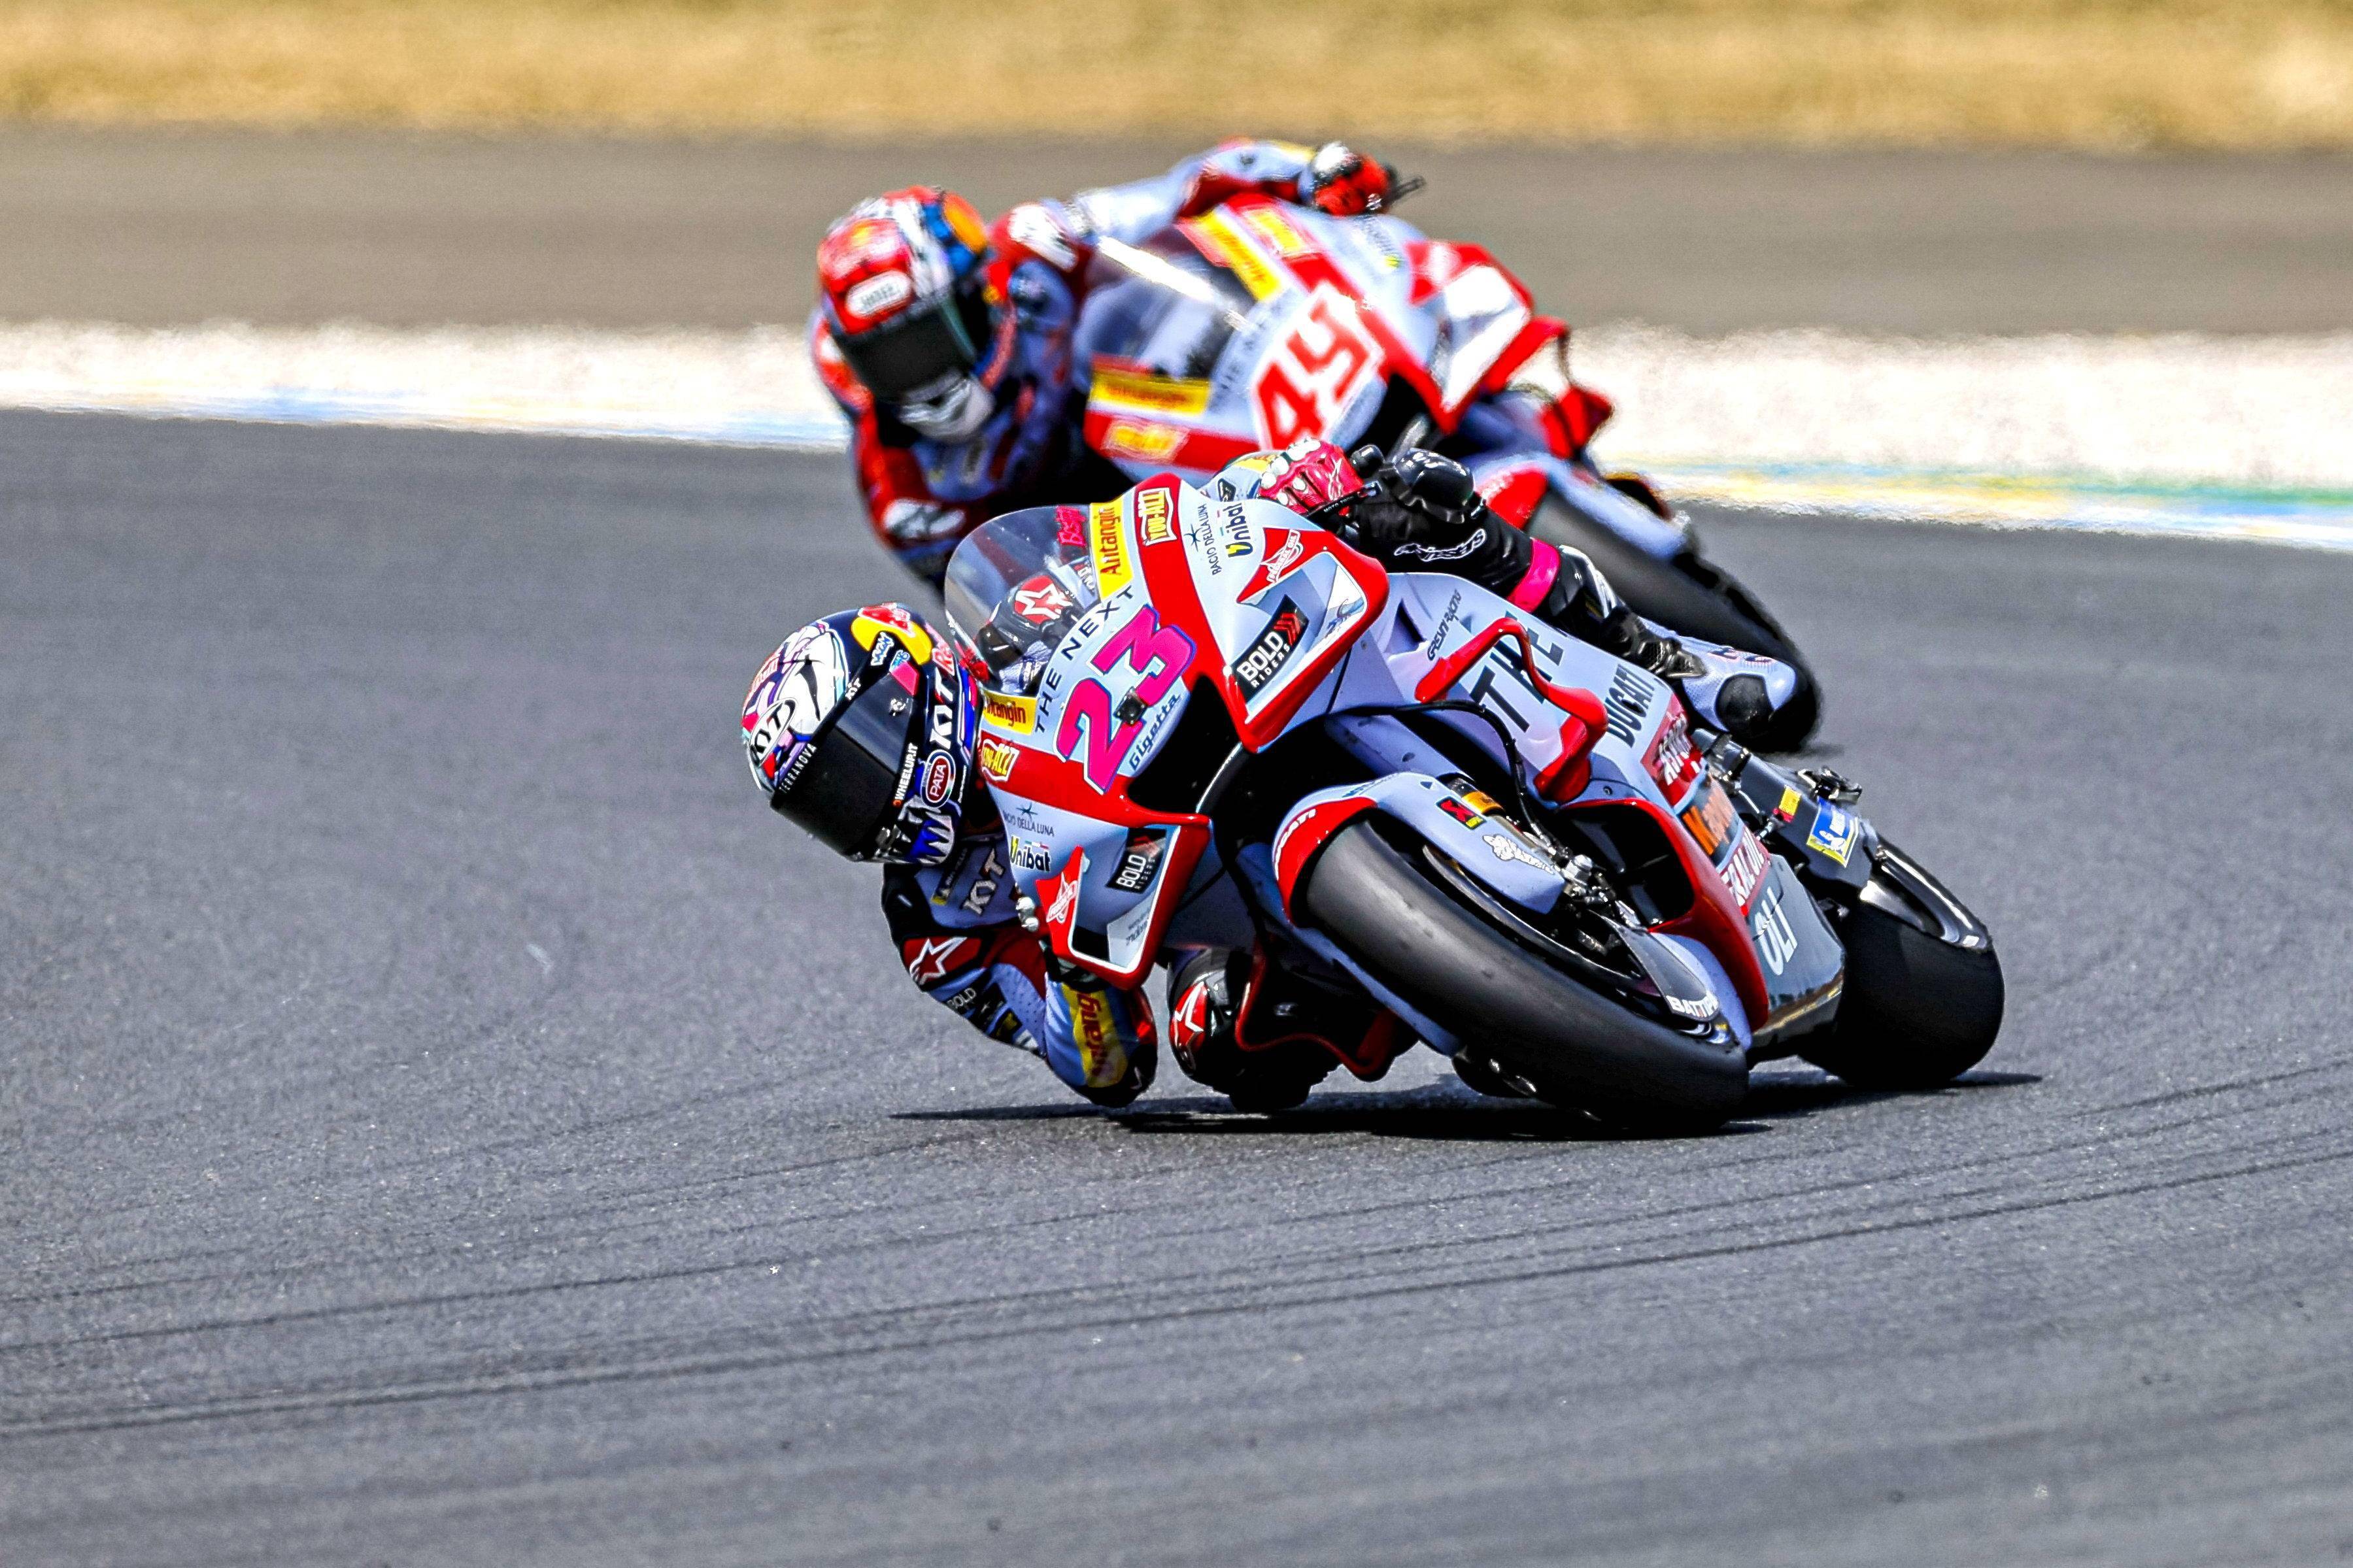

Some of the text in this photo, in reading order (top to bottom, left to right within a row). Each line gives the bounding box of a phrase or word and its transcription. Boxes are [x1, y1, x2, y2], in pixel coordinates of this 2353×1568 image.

[1256, 296, 1371, 451] 49
[1206, 548, 1223, 576] BACIO
[1035, 668, 1063, 733] THE
[1060, 585, 1134, 661] NEXT
[1236, 631, 1284, 682] BOLD
[1251, 643, 1291, 689] RIDERS
[1053, 603, 1197, 795] 23
[1604, 663, 1655, 749] DUCATI
[778, 742, 817, 794] TERRANOVA
[929, 763, 947, 798] PATA
[1010, 836, 1051, 872] Unibat
[1037, 823, 1055, 838] LUNA
[961, 848, 1004, 915] KYT
[1115, 854, 1147, 888] BOLD
[1754, 885, 1798, 976] OLI
